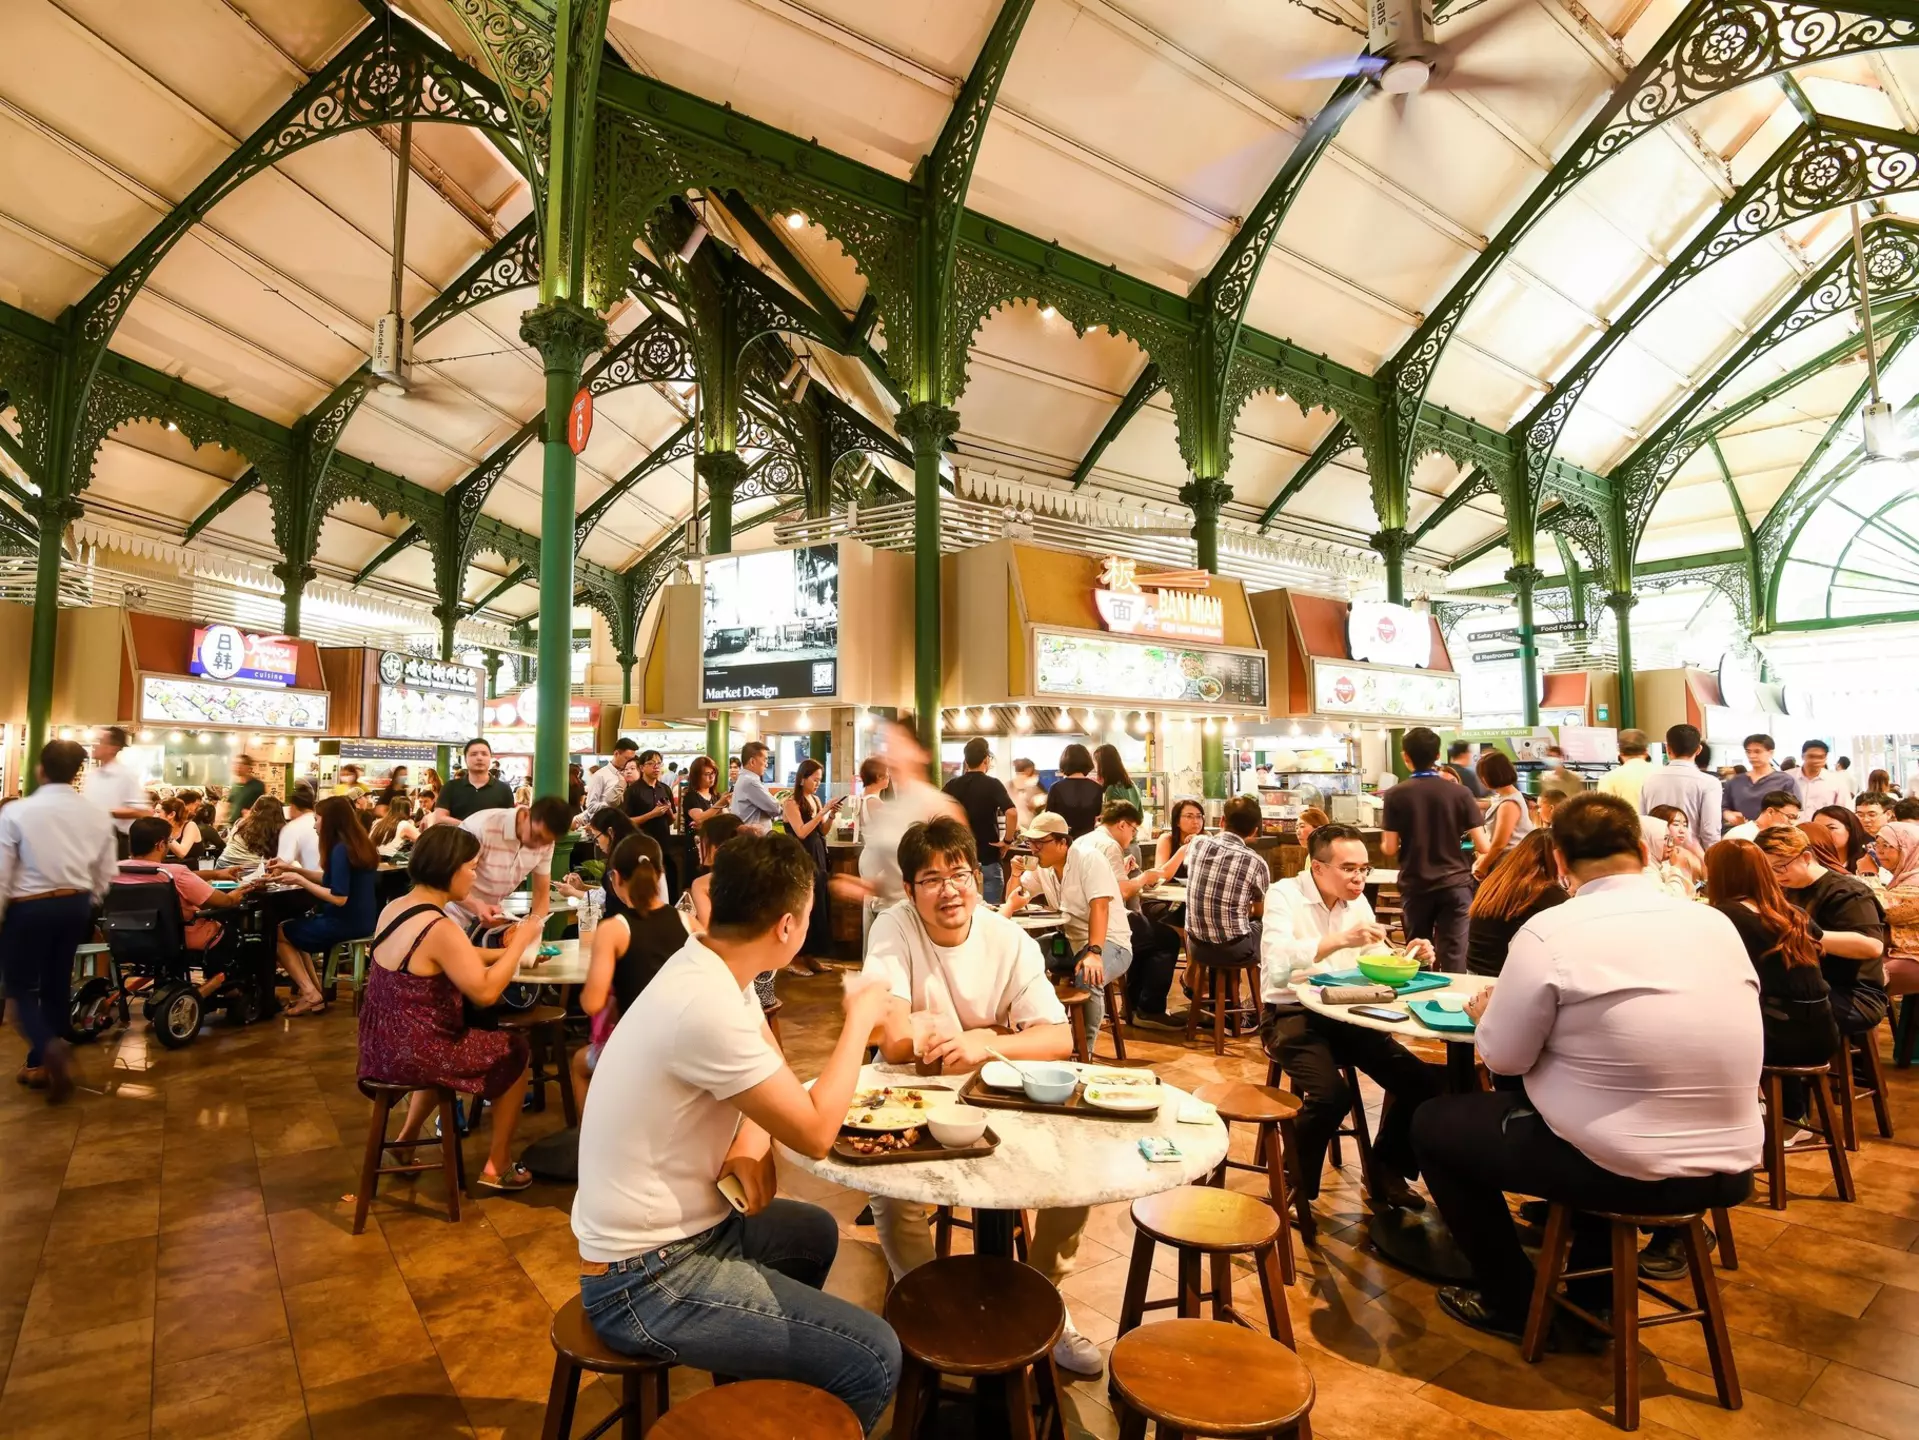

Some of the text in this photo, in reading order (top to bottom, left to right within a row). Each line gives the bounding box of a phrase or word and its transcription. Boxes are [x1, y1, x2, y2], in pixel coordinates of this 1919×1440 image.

[376, 318, 386, 359] Spacefans
[576, 413, 583, 442] 6
[1100, 556, 1141, 594] 板
[1110, 598, 1134, 621] 面
[1158, 588, 1222, 626] BAN MIAN
[1559, 623, 1577, 631] Folks
[1481, 651, 1514, 660] Restrooms
[254, 671, 283, 681] cuisine
[705, 684, 779, 699] Market Design
